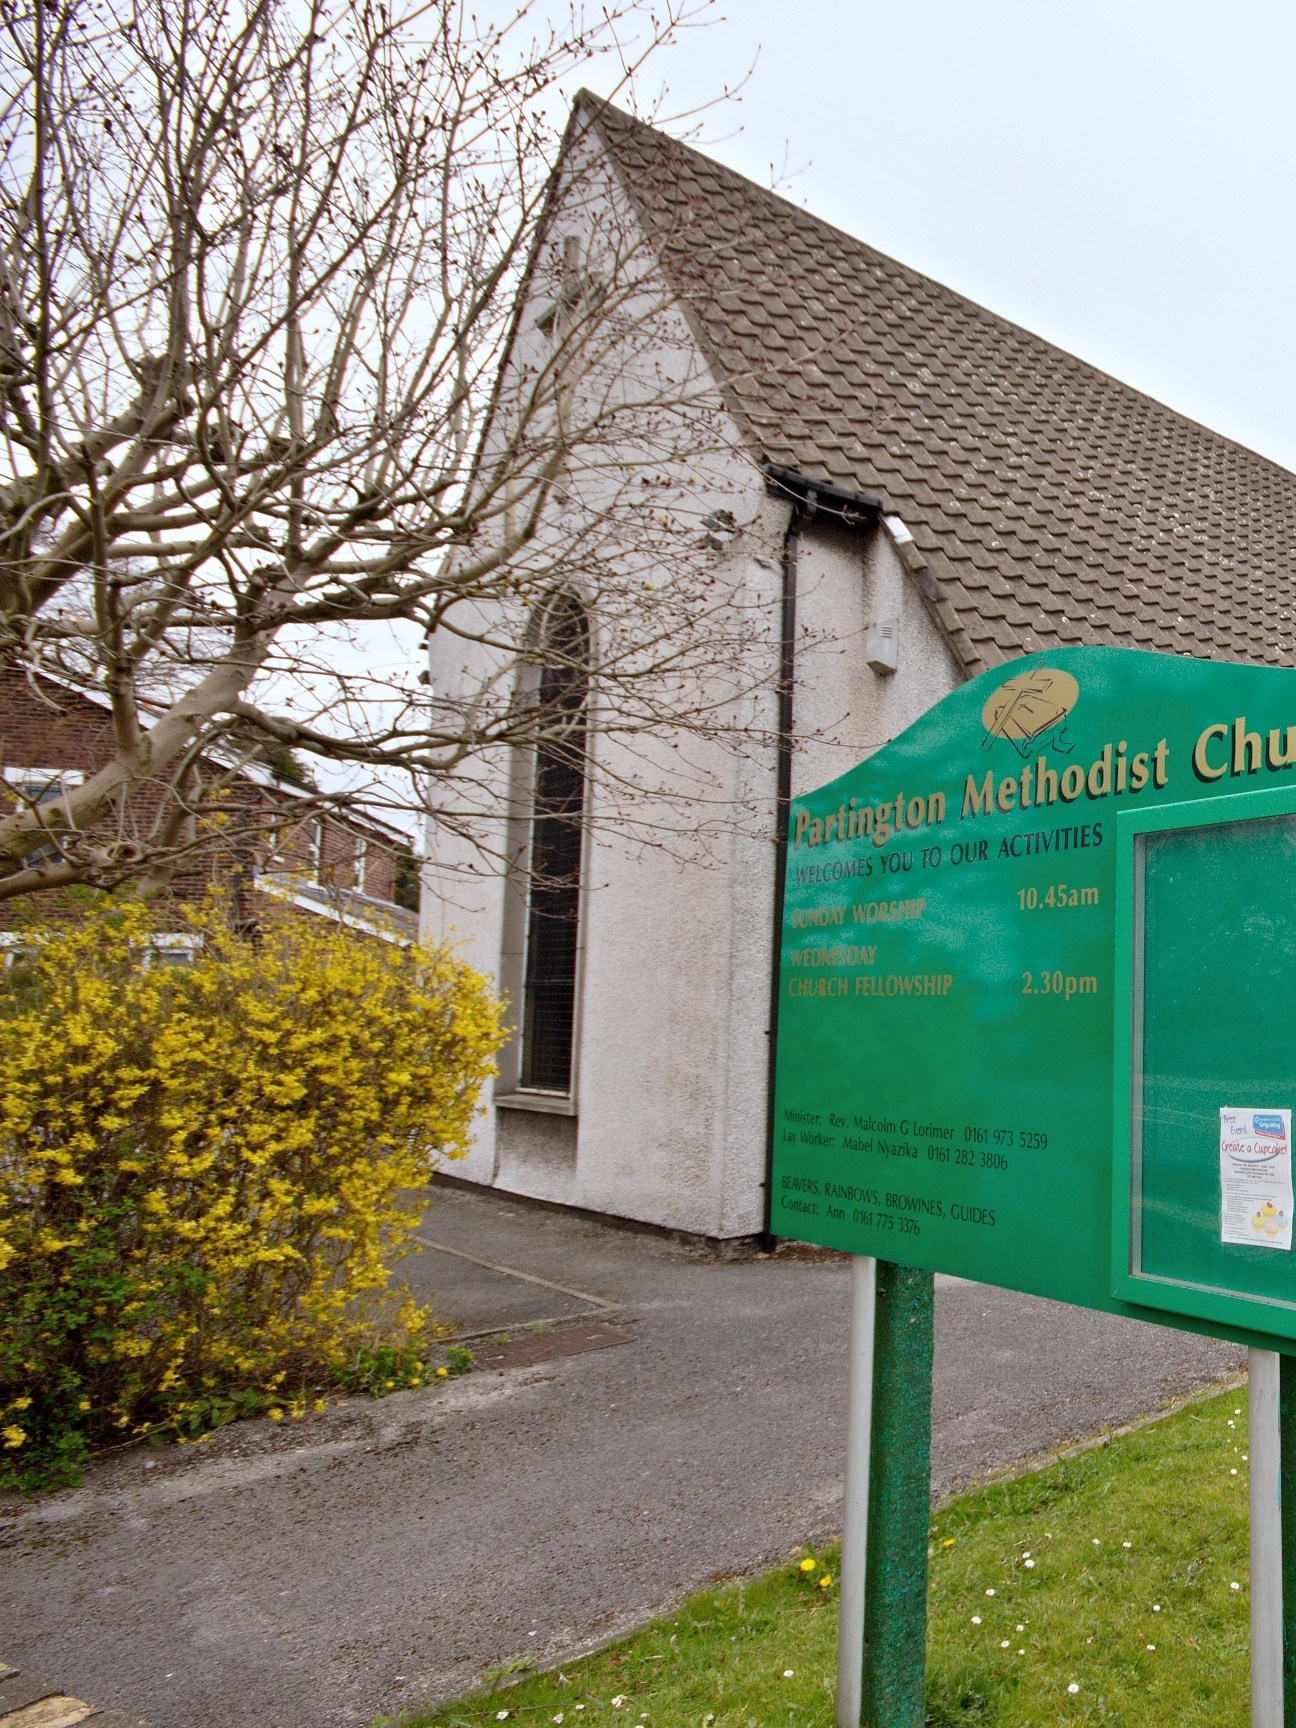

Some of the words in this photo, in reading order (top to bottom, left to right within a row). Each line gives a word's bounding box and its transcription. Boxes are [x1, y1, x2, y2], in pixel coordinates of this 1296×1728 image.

[794, 791, 946, 850] Partington
[960, 737, 1170, 821] Methodist
[796, 856, 873, 885] WELCOMES
[880, 850, 913, 875] YOU
[921, 846, 942, 869] TO
[950, 840, 988, 865] OUR
[998, 822, 1103, 859] ACTIVITIES
[792, 906, 846, 929] SUNDAY
[852, 897, 926, 924] WORSHIP
[1017, 884, 1099, 911] 10.45am
[790, 945, 877, 968] WEDNESDAY
[788, 976, 849, 998] CHURCH
[855, 973, 953, 997] FELLOWSHIP
[1021, 970, 1098, 1001] 2.30pm
[784, 1109, 822, 1126] Minister:
[829, 1112, 849, 1129] Rev.
[853, 1115, 896, 1134] Malcolm
[900, 1119, 909, 1135] G
[913, 1121, 955, 1141] Lorimer
[964, 1126, 988, 1144] 0161
[993, 1129, 1014, 1147] 973
[1019, 1131, 1048, 1150] 5259
[1223, 1115, 1237, 1124] Free
[1230, 1126, 1248, 1136] Event
[783, 1128, 797, 1146] Lay
[800, 1130, 835, 1148] Worker:
[842, 1136, 873, 1153] Mabel
[877, 1140, 918, 1159] Nyazika
[927, 1145, 951, 1162] 0161
[955, 1148, 975, 1166] 282
[979, 1151, 1008, 1170] 3806
[1221, 1140, 1245, 1153] Create
[1246, 1144, 1252, 1153] a
[781, 1175, 821, 1195] BEAVERS,
[824, 1182, 881, 1208] RAINBOWS,
[885, 1192, 946, 1220] BROWINES,
[950, 1203, 996, 1226] GUIDES
[781, 1195, 819, 1215] Contact:
[826, 1205, 845, 1220] Ann
[853, 1209, 873, 1226] 0161
[877, 1213, 894, 1230] 775
[898, 1217, 920, 1235] 3376
